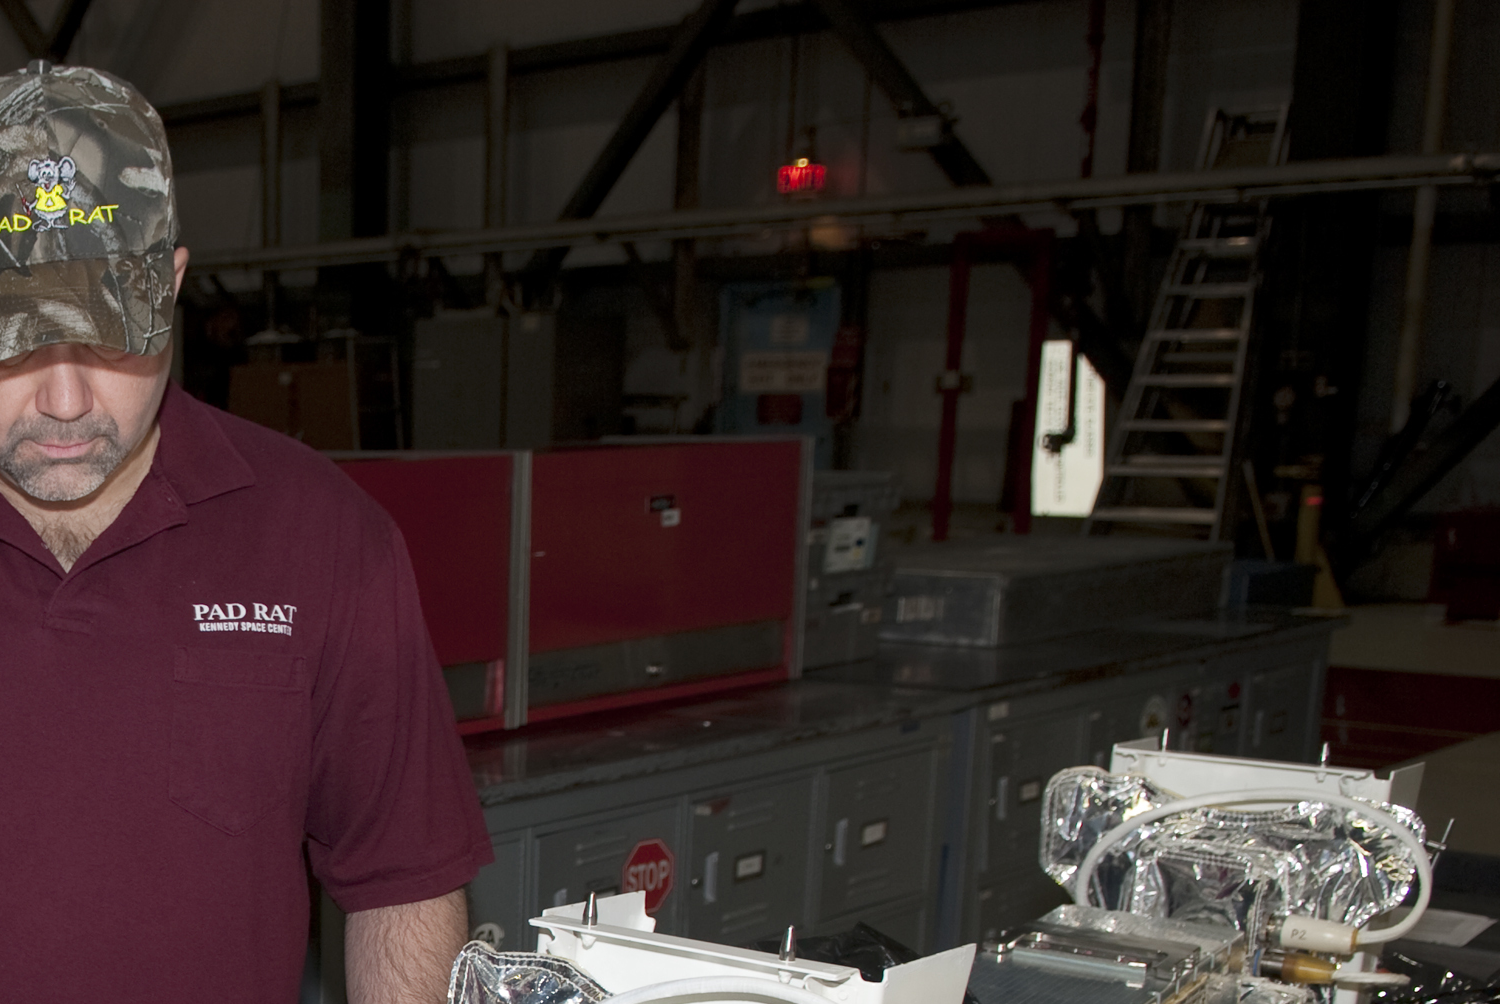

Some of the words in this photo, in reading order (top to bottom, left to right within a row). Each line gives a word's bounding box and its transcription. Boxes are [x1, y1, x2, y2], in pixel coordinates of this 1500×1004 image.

[69, 204, 119, 226] RAT
[192, 603, 247, 621] PAD
[252, 602, 297, 624] RAT
[199, 622, 239, 632] KENNEDY
[240, 622, 267, 632] SPACE
[267, 623, 292, 636] CENTER
[628, 859, 670, 891] STOP
[1291, 929, 1307, 940] P2
